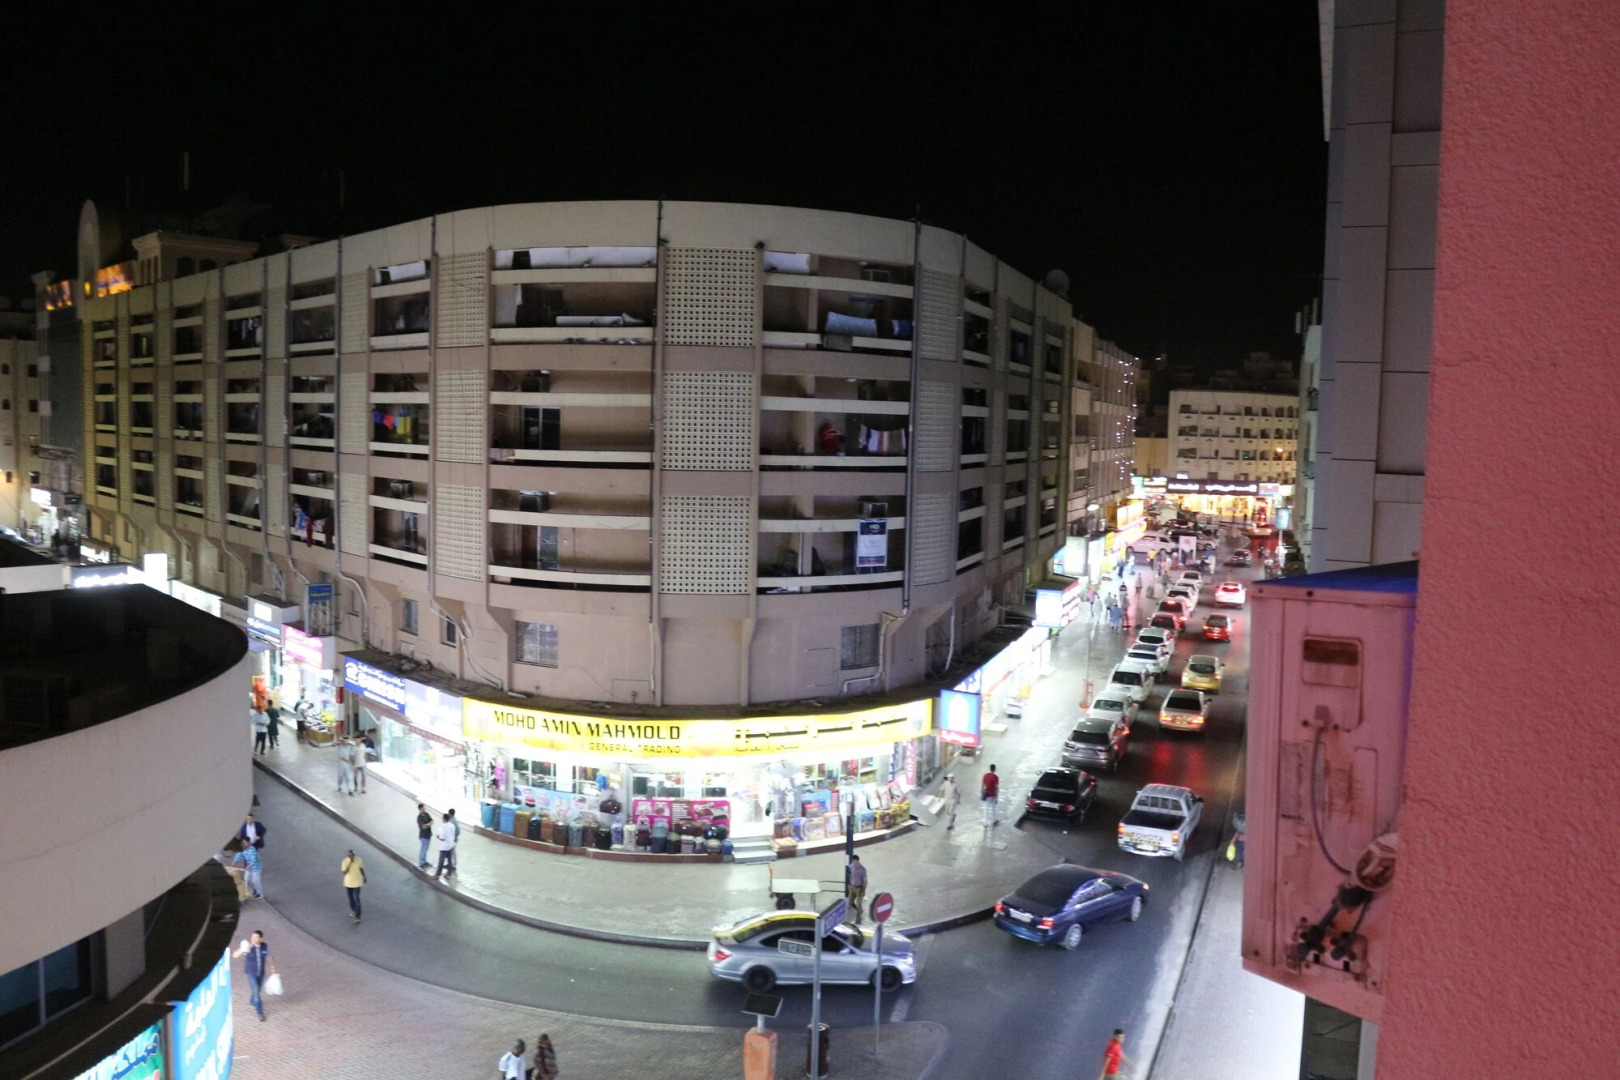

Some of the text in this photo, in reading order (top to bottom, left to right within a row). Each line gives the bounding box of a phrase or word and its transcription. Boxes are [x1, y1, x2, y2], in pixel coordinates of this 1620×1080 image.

[494, 710, 536, 730] MOHD
[541, 718, 581, 736] AMIN
[589, 741, 681, 754] GENERAL TRADING
